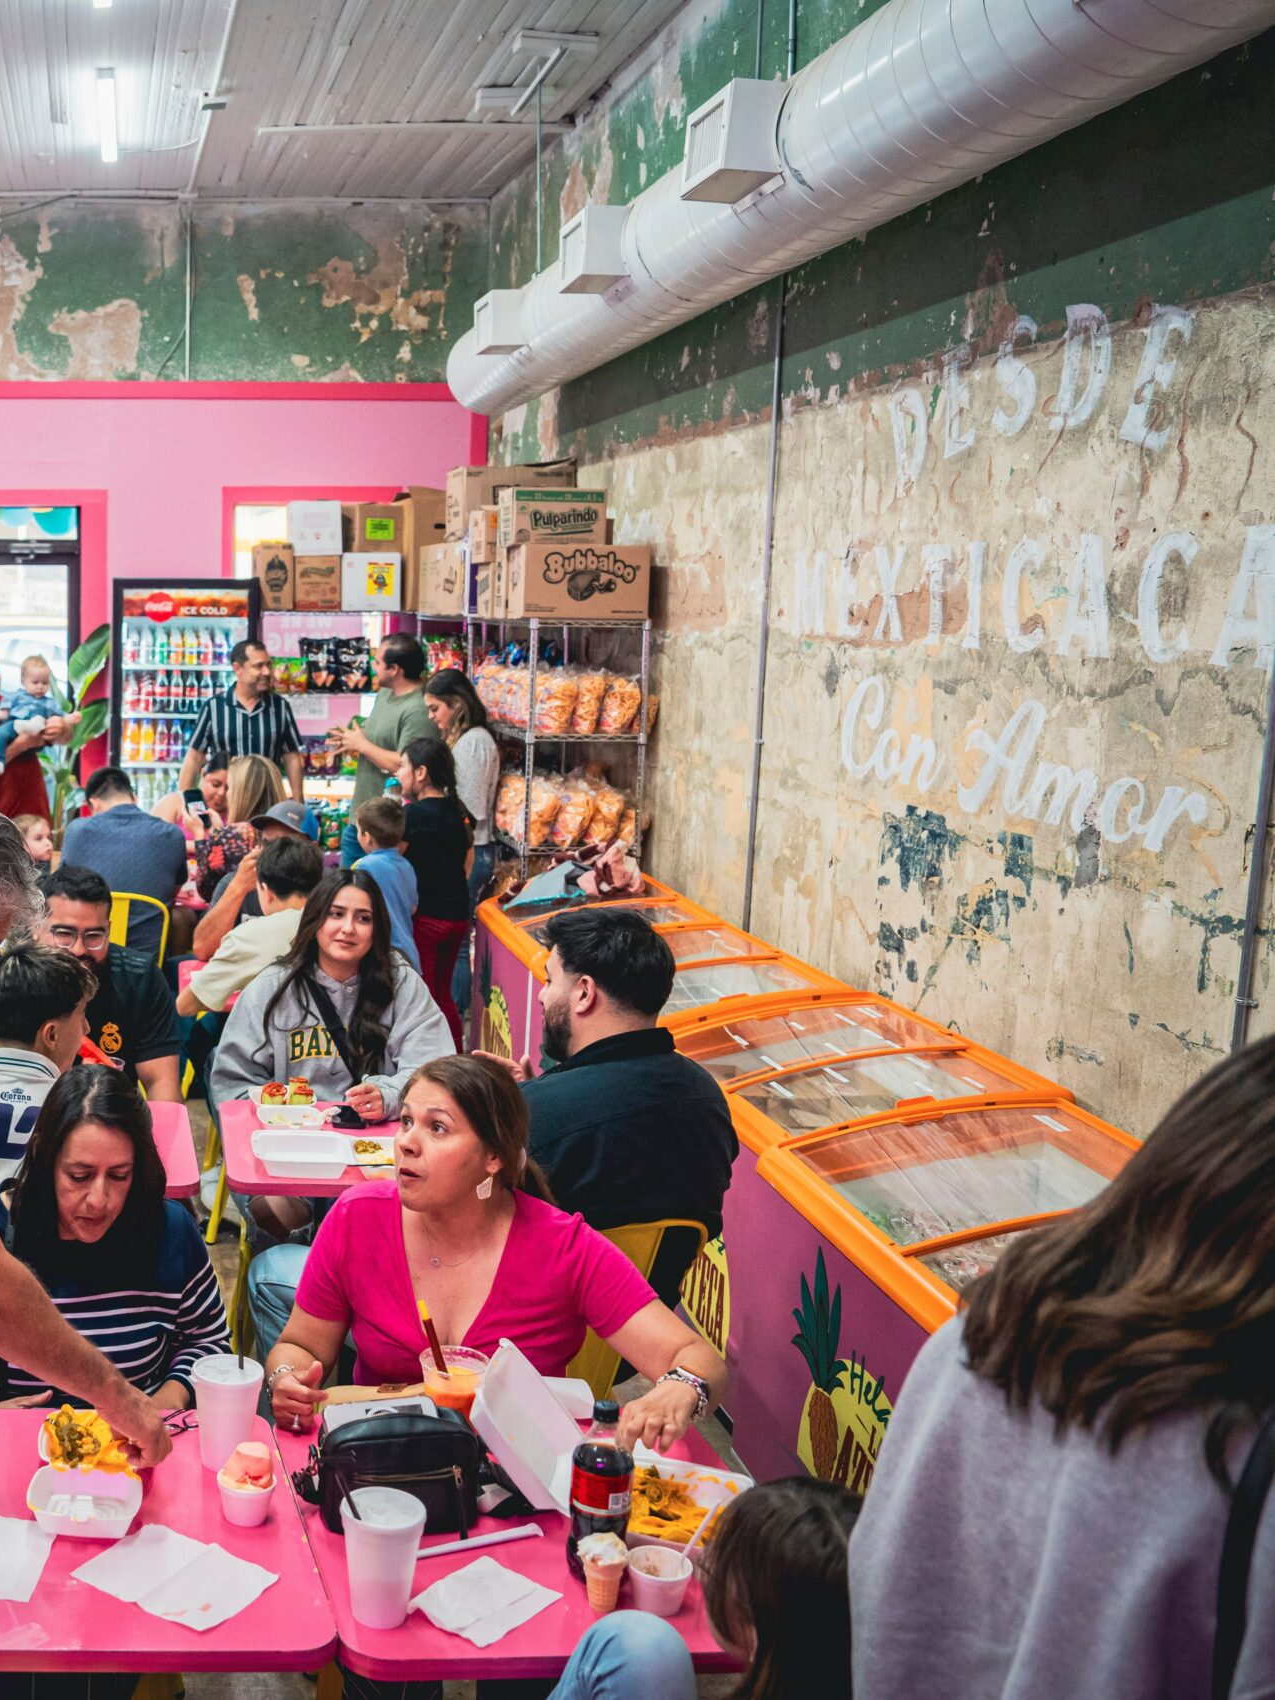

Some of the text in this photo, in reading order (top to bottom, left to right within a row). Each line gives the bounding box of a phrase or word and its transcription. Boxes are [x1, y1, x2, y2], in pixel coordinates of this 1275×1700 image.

[888, 303, 1193, 499] DESDE
[532, 508, 599, 530] Pulparindo
[543, 549, 637, 584] Bubbaloo
[180, 606, 228, 615] ICE COLD
[841, 674, 1208, 853] Con Amor
[290, 1026, 342, 1063] BAY
[0, 1091, 32, 1101] Corona
